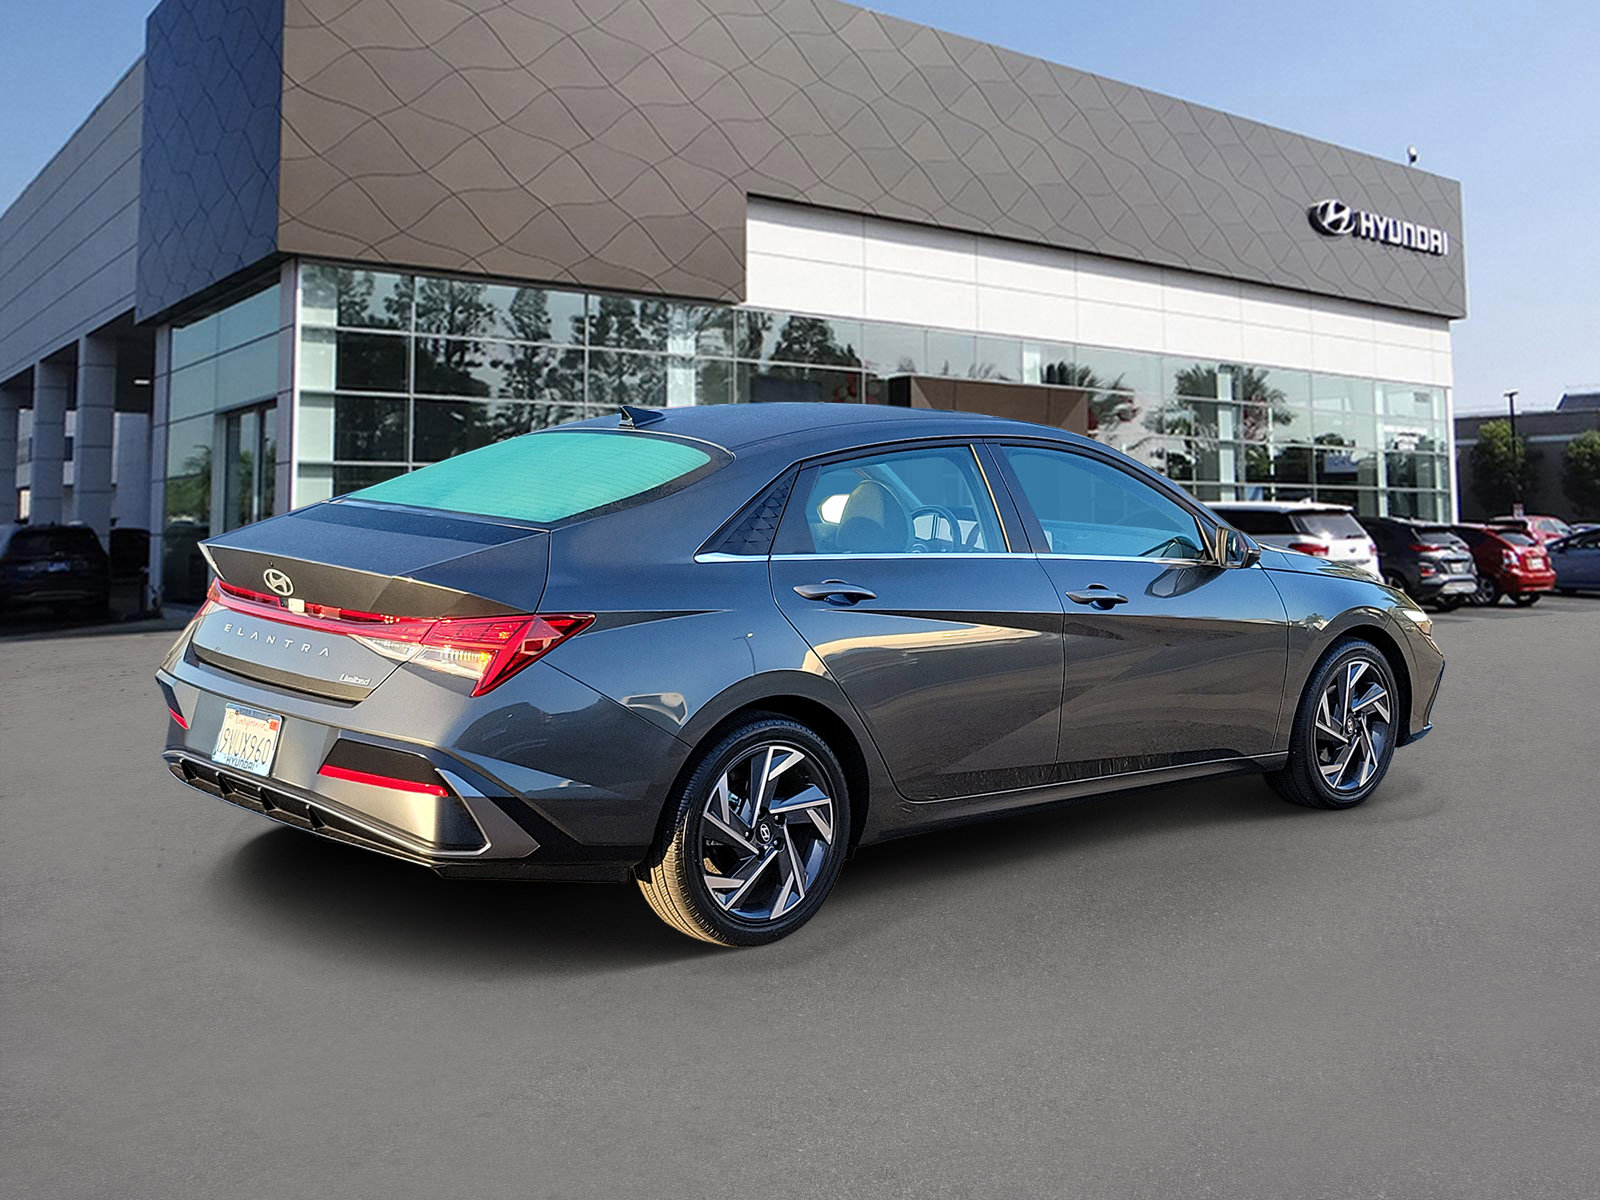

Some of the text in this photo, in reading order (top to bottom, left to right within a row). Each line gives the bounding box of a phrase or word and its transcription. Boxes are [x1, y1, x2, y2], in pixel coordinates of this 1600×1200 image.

[1359, 211, 1448, 255] HYUNDAI
[224, 623, 329, 657] ELANTRA
[339, 673, 371, 686] Limited
[225, 755, 255, 771] HYUNDAI
